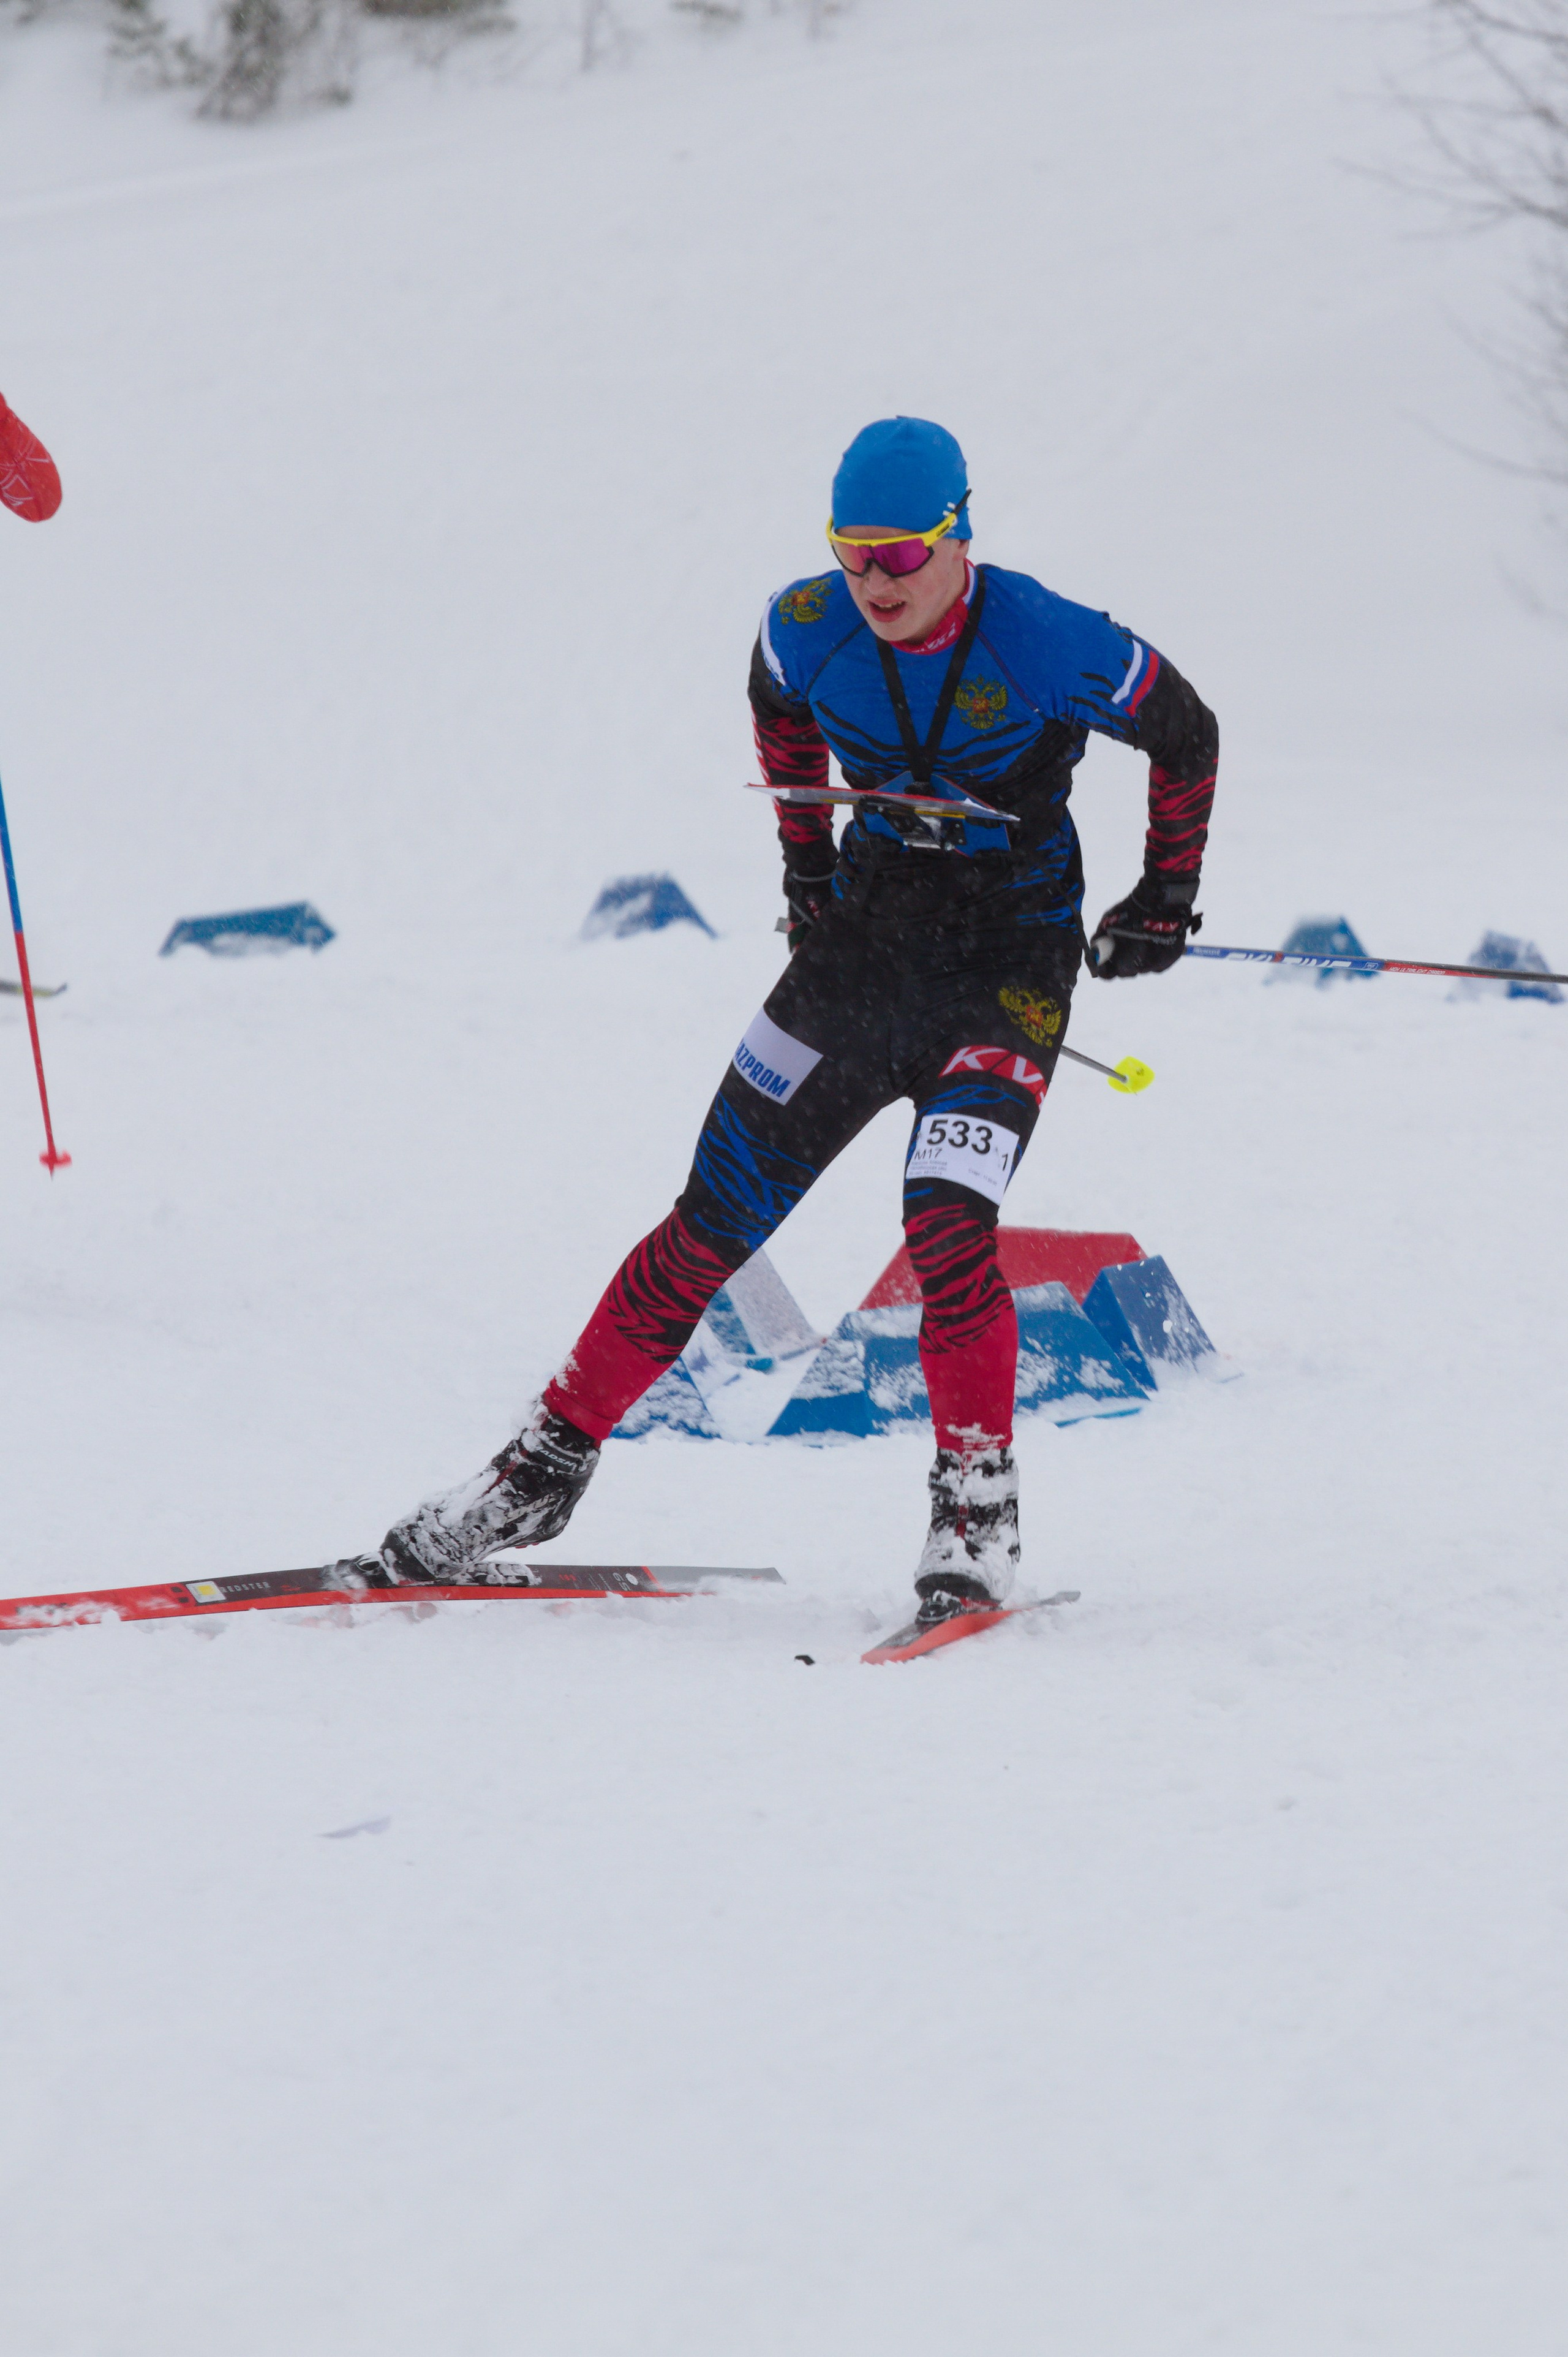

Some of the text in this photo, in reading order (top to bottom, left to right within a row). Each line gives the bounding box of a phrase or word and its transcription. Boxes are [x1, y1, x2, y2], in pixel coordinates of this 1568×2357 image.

[734, 1040, 791, 1097] AZPROM
[927, 1119, 992, 1155] 533
[914, 1148, 943, 1160] M17
[220, 1582, 271, 1593] REDSTER
